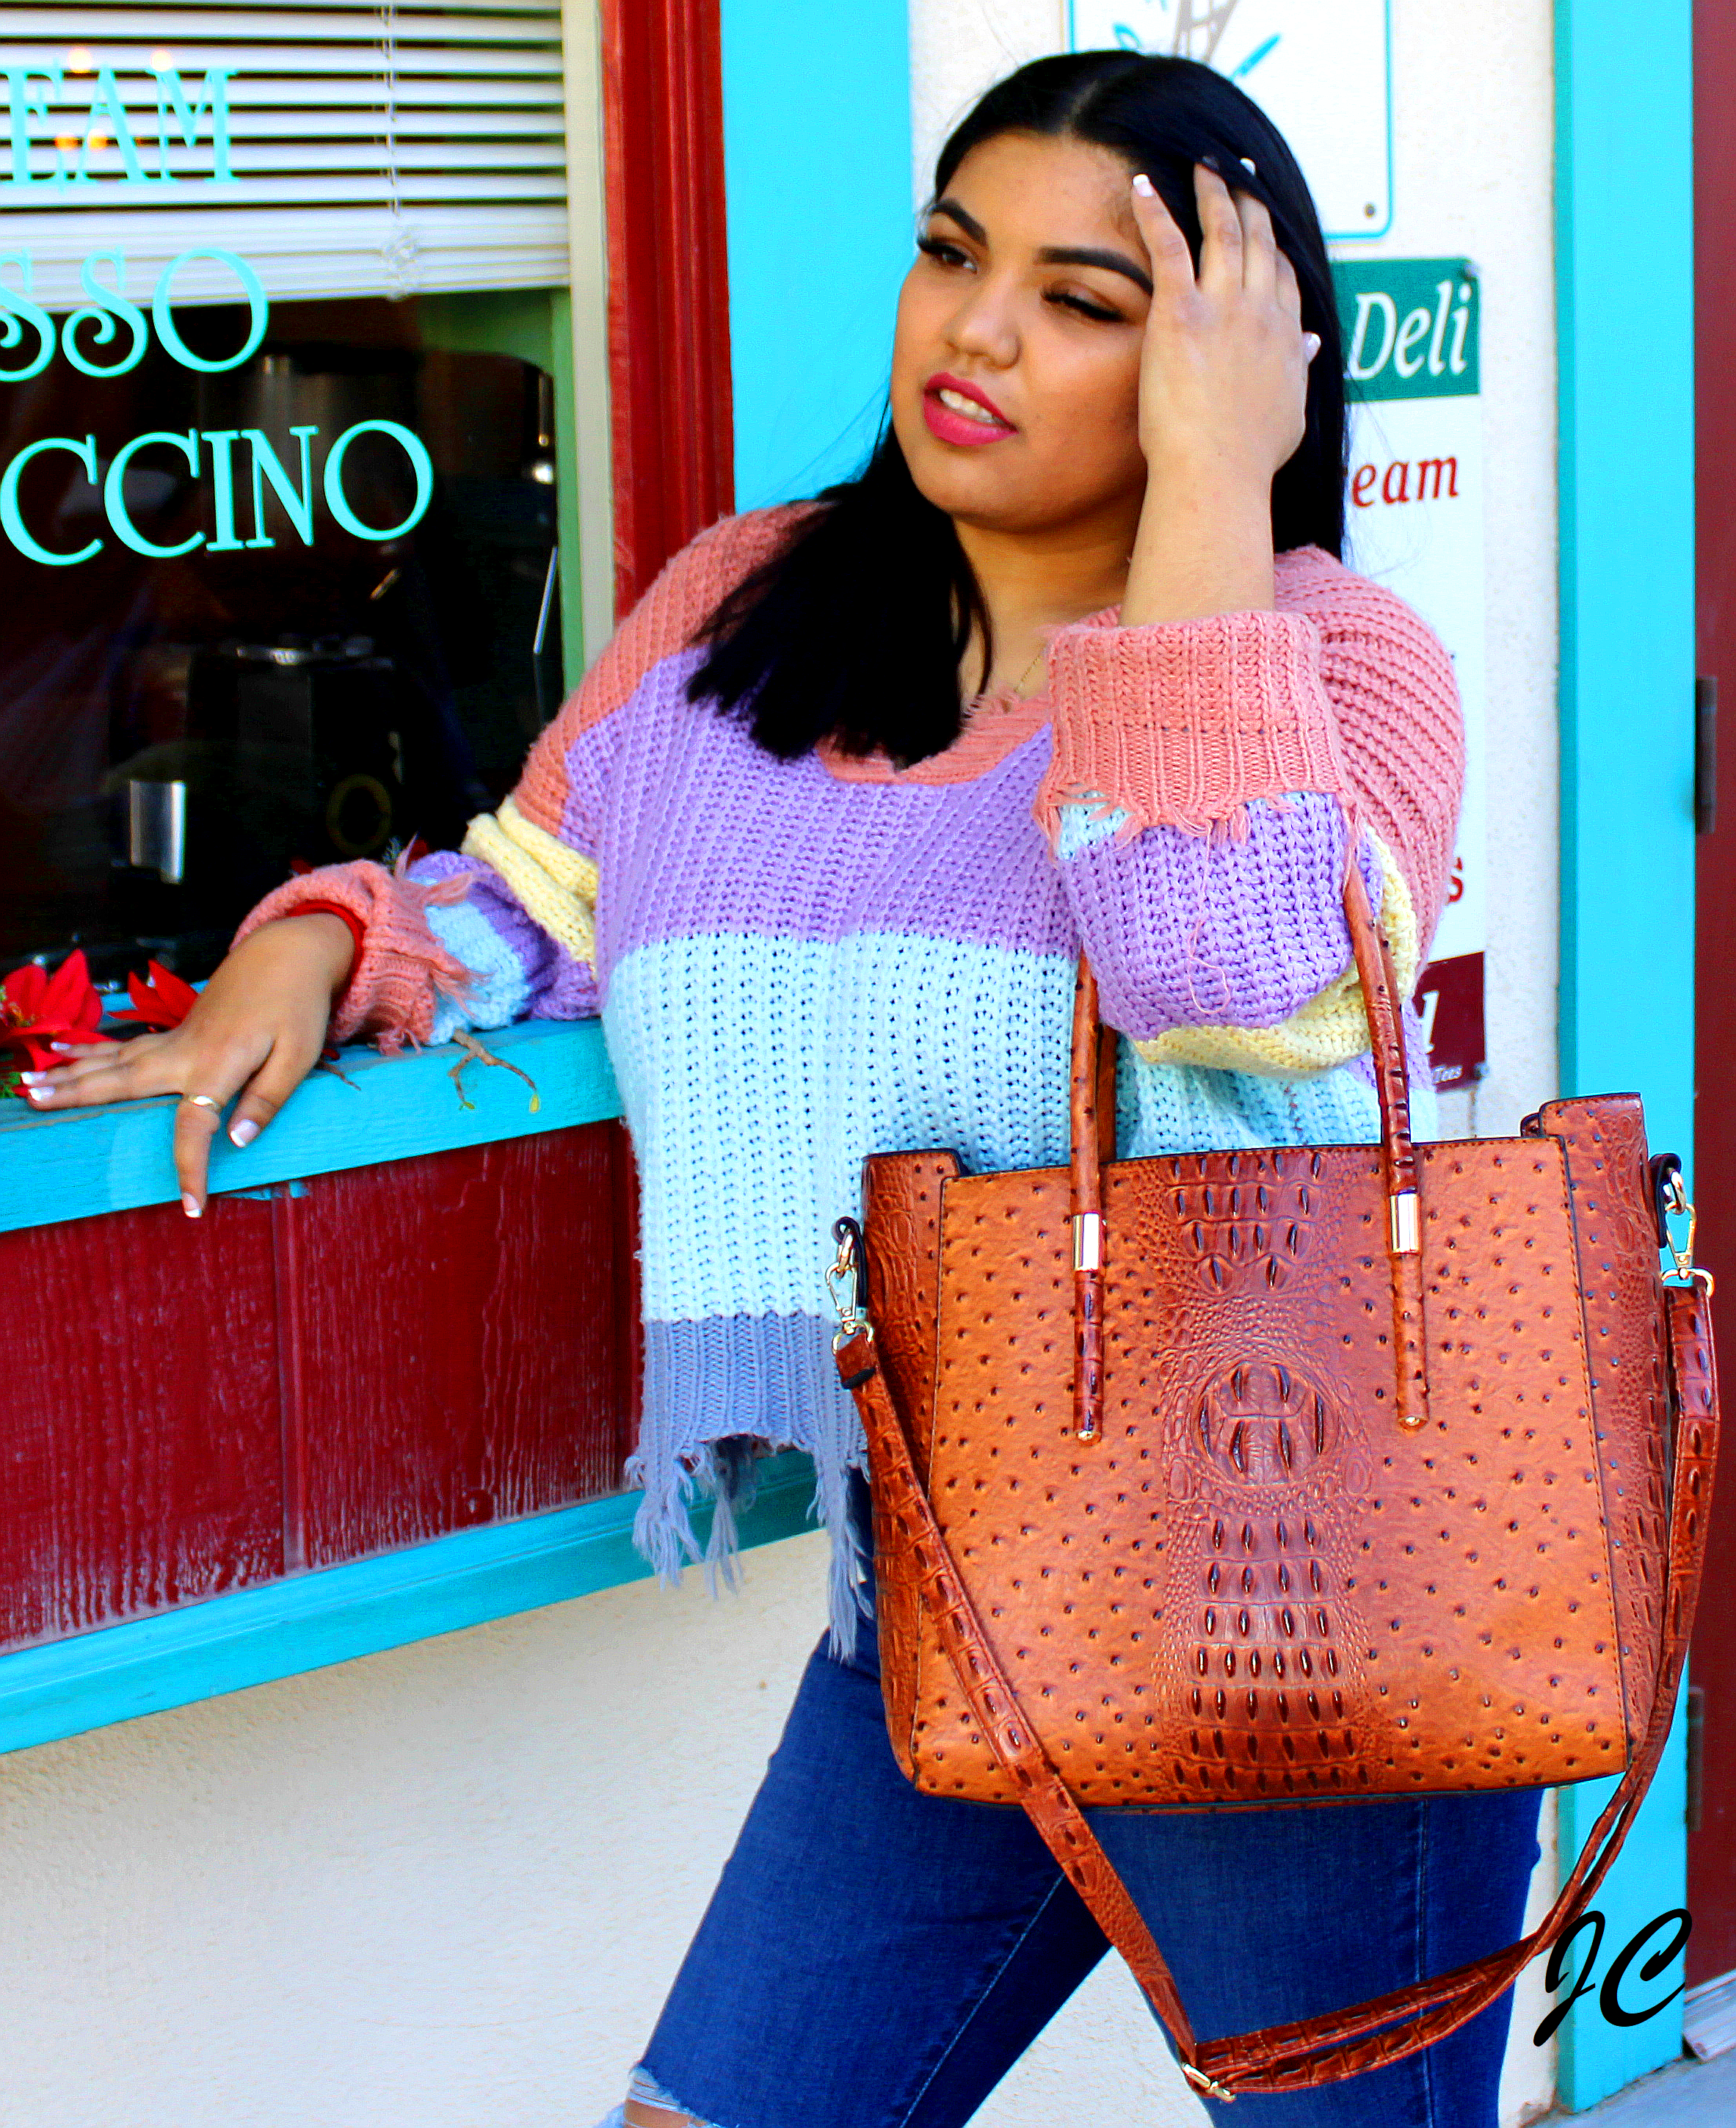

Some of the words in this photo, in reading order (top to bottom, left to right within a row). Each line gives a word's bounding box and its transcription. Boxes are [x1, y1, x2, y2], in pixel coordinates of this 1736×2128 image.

[0, 59, 241, 194] EAM
[0, 246, 269, 382] SSO
[1343, 279, 1471, 380] Deli
[0, 419, 434, 567] CCINO
[1351, 456, 1459, 508] eam
